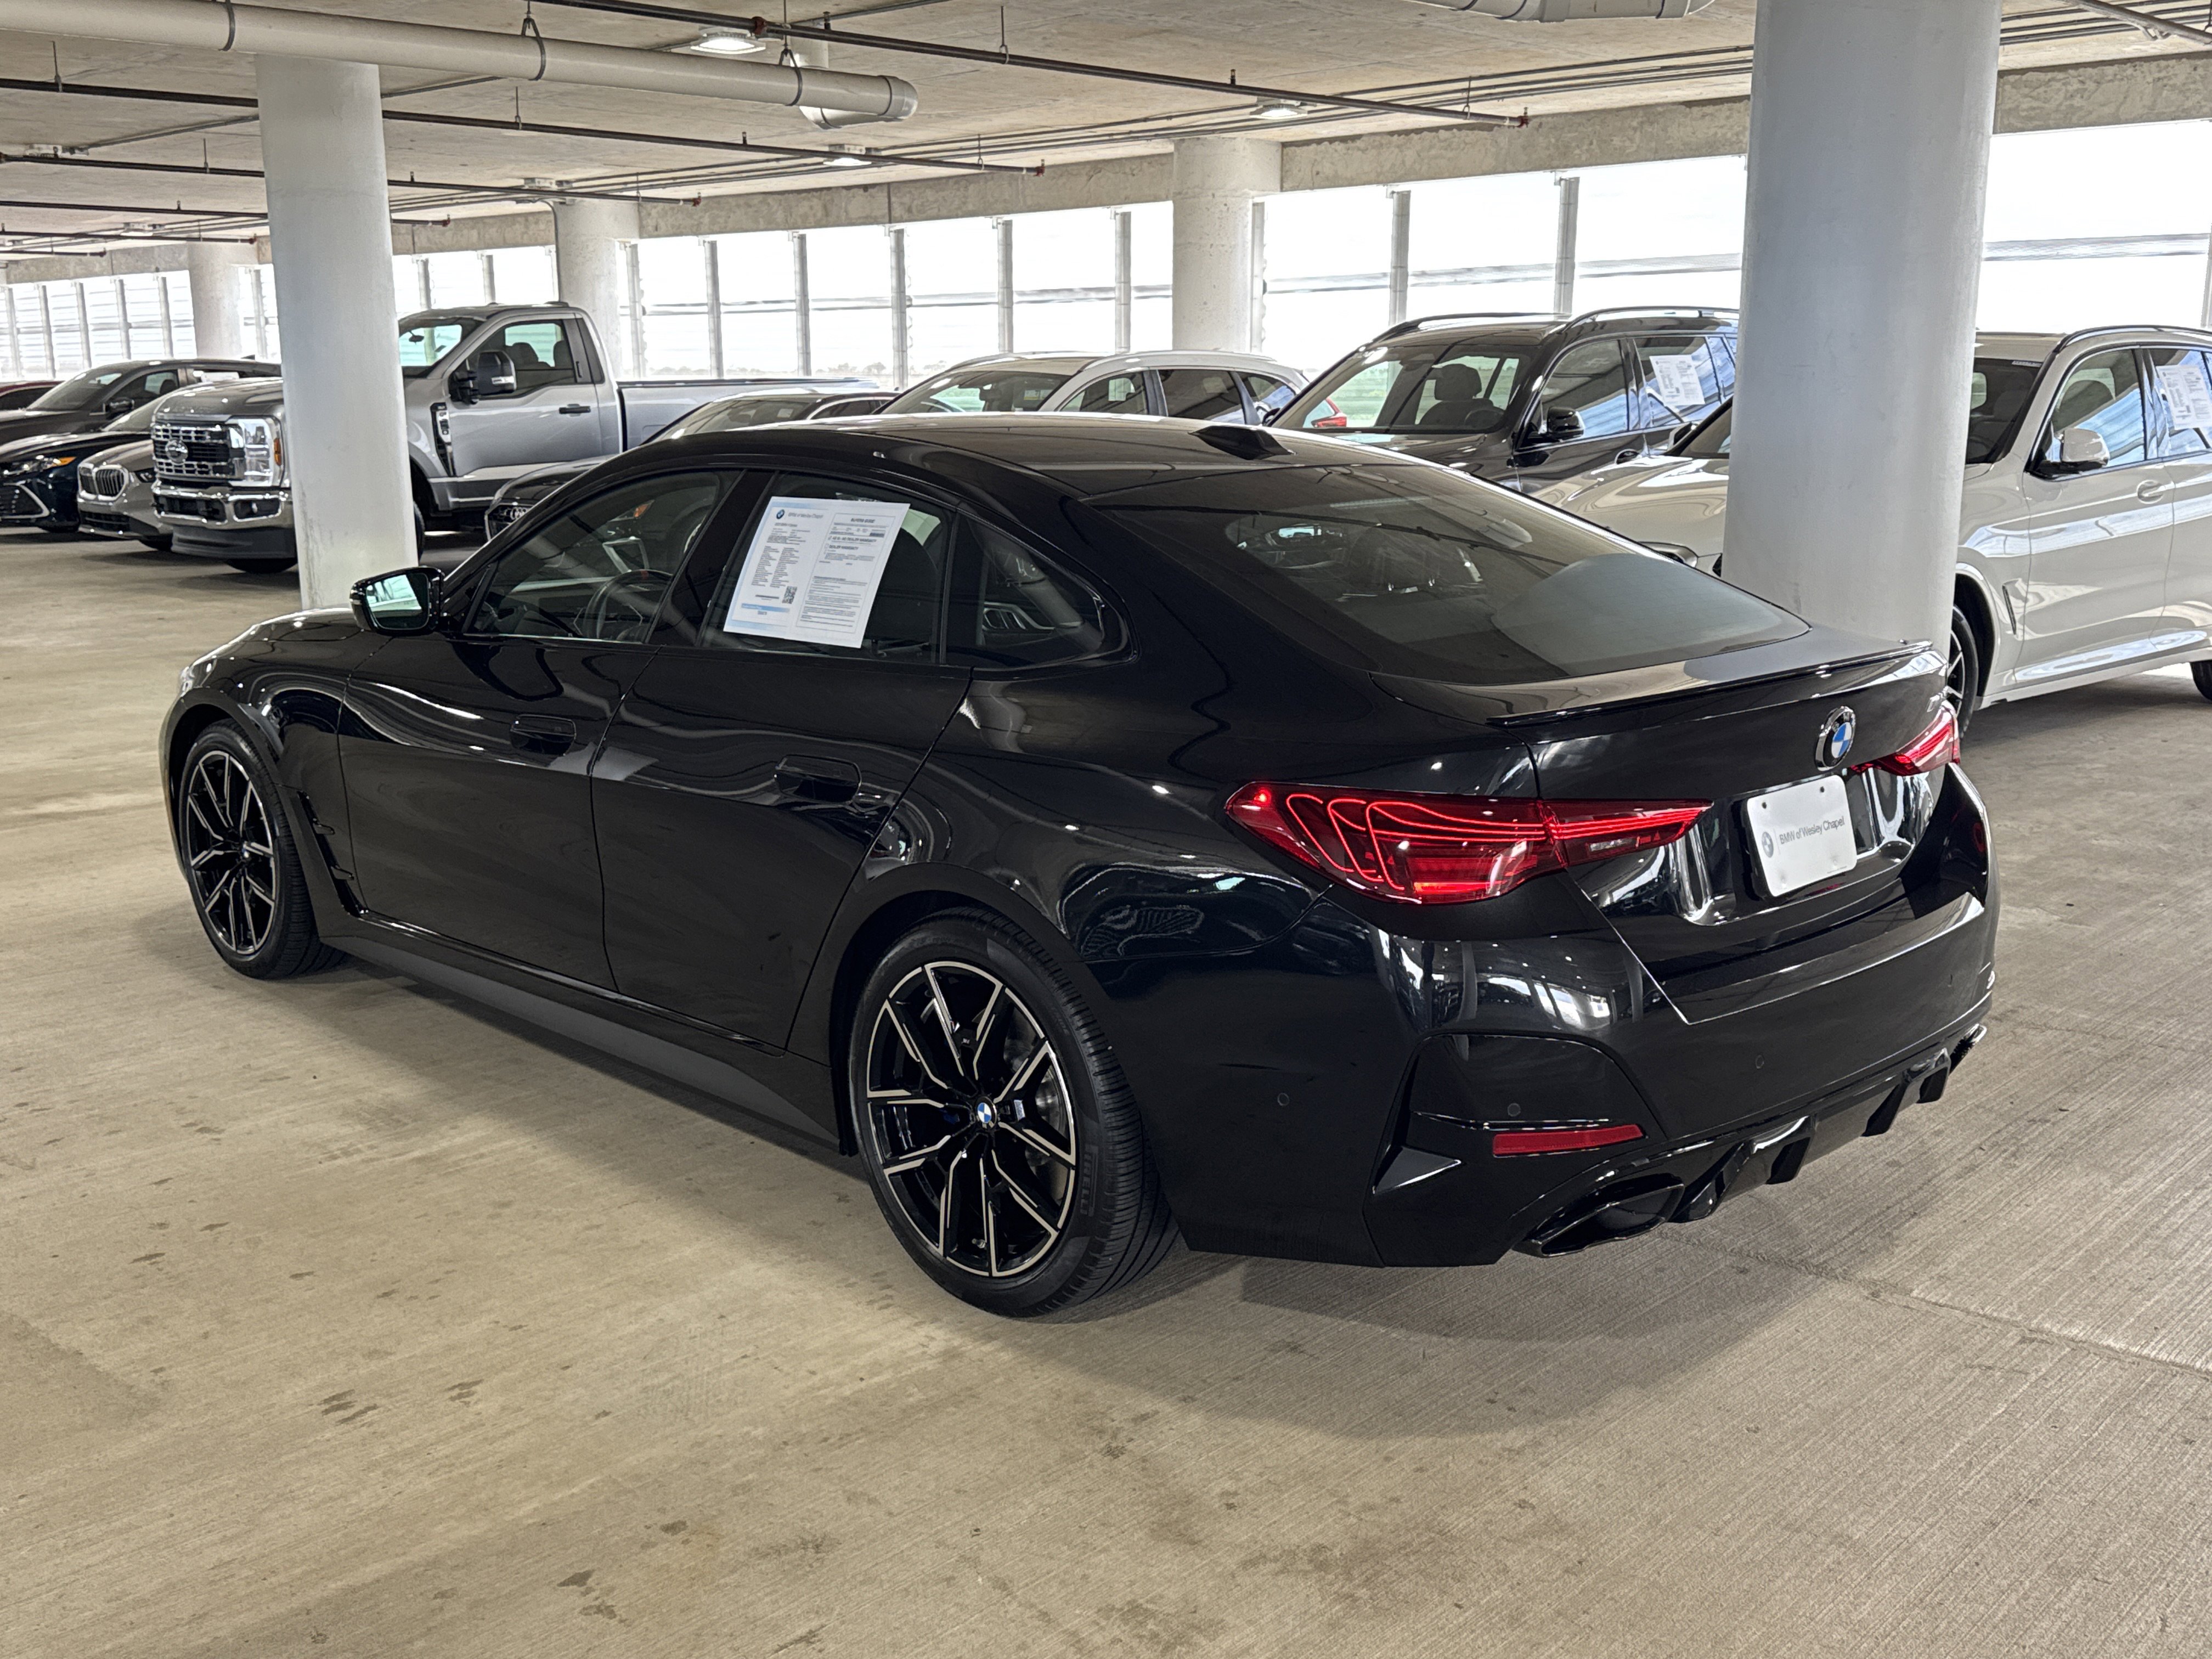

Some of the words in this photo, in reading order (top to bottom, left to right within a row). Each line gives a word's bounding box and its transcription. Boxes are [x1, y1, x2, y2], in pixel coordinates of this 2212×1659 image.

[1779, 830, 1795, 844] BMW
[1796, 828, 1801, 839] of
[1801, 824, 1822, 837] Wesley
[1823, 816, 1845, 831] Chapel
[1080, 1144, 1098, 1216] PIRELLI
